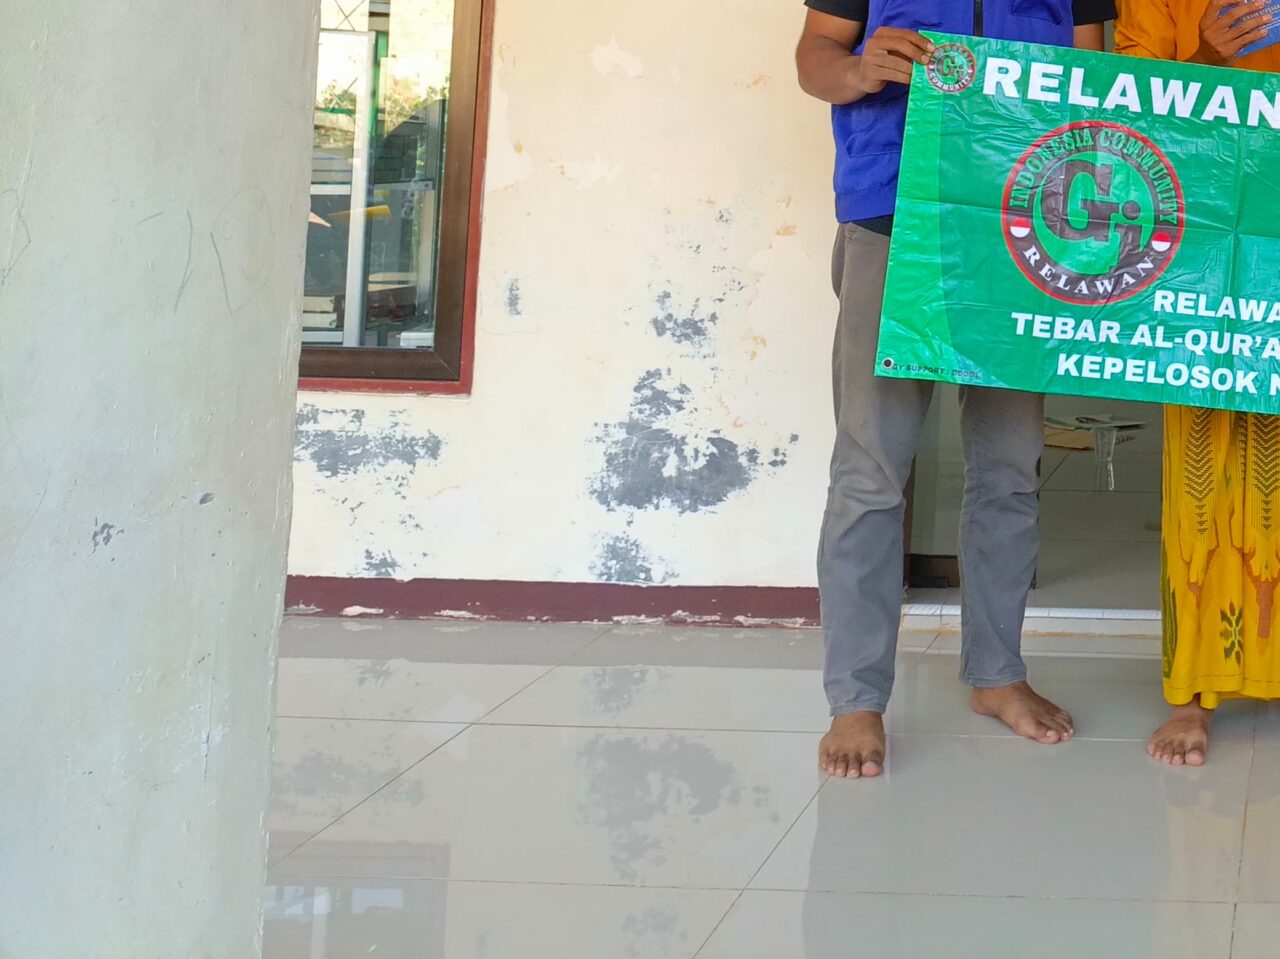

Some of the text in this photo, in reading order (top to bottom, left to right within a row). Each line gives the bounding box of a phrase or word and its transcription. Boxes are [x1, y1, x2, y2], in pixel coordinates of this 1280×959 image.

[1009, 127, 1178, 225] INDONESIA COMMUNITY
[1022, 244, 1155, 295] RELAWAN
[1011, 311, 1122, 345] TEBAR
[1056, 352, 1260, 395] KEPELOSOK
